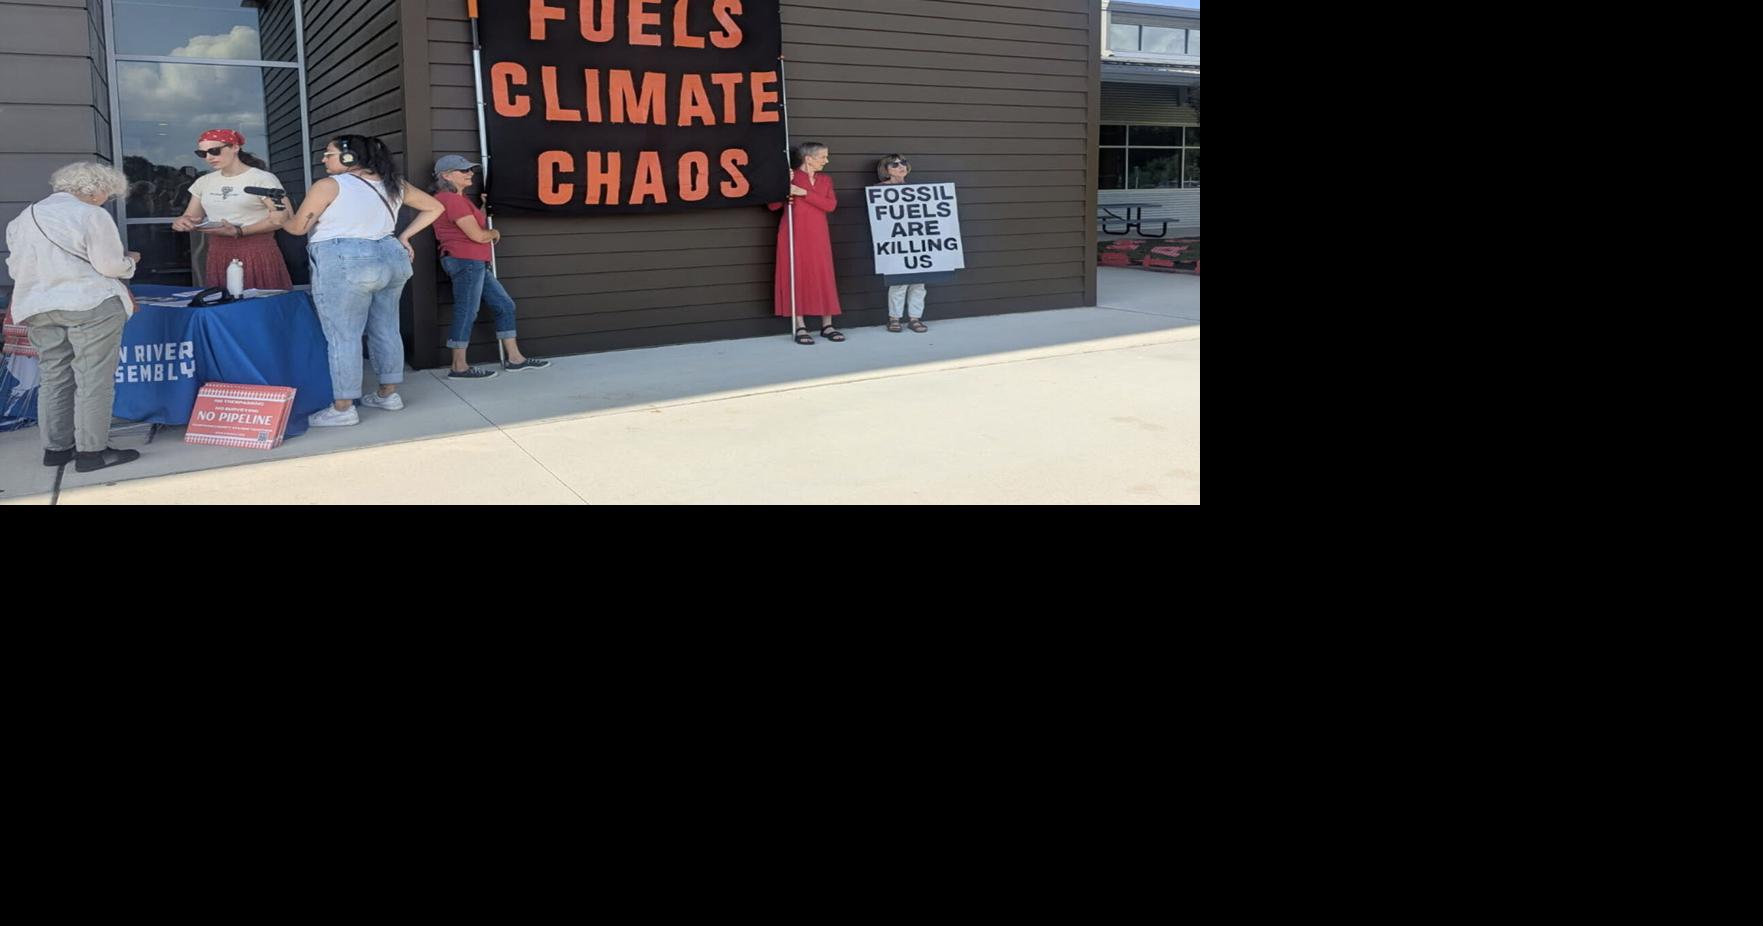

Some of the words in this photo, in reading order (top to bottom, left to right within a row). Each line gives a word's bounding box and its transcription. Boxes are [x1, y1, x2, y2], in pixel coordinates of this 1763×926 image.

[529, 0, 744, 49] FUELS
[490, 61, 780, 126] CLIMATE
[537, 148, 750, 206] CHAOS
[868, 185, 954, 204] FOSSIL
[875, 202, 951, 220] FUELS
[891, 220, 941, 238] ARE
[876, 237, 958, 255] KILLING
[904, 255, 933, 269] US
[134, 341, 194, 363] RIVER
[115, 360, 196, 383] SEMBLY
[197, 410, 216, 422] NO
[219, 412, 274, 426] PIPELINE
